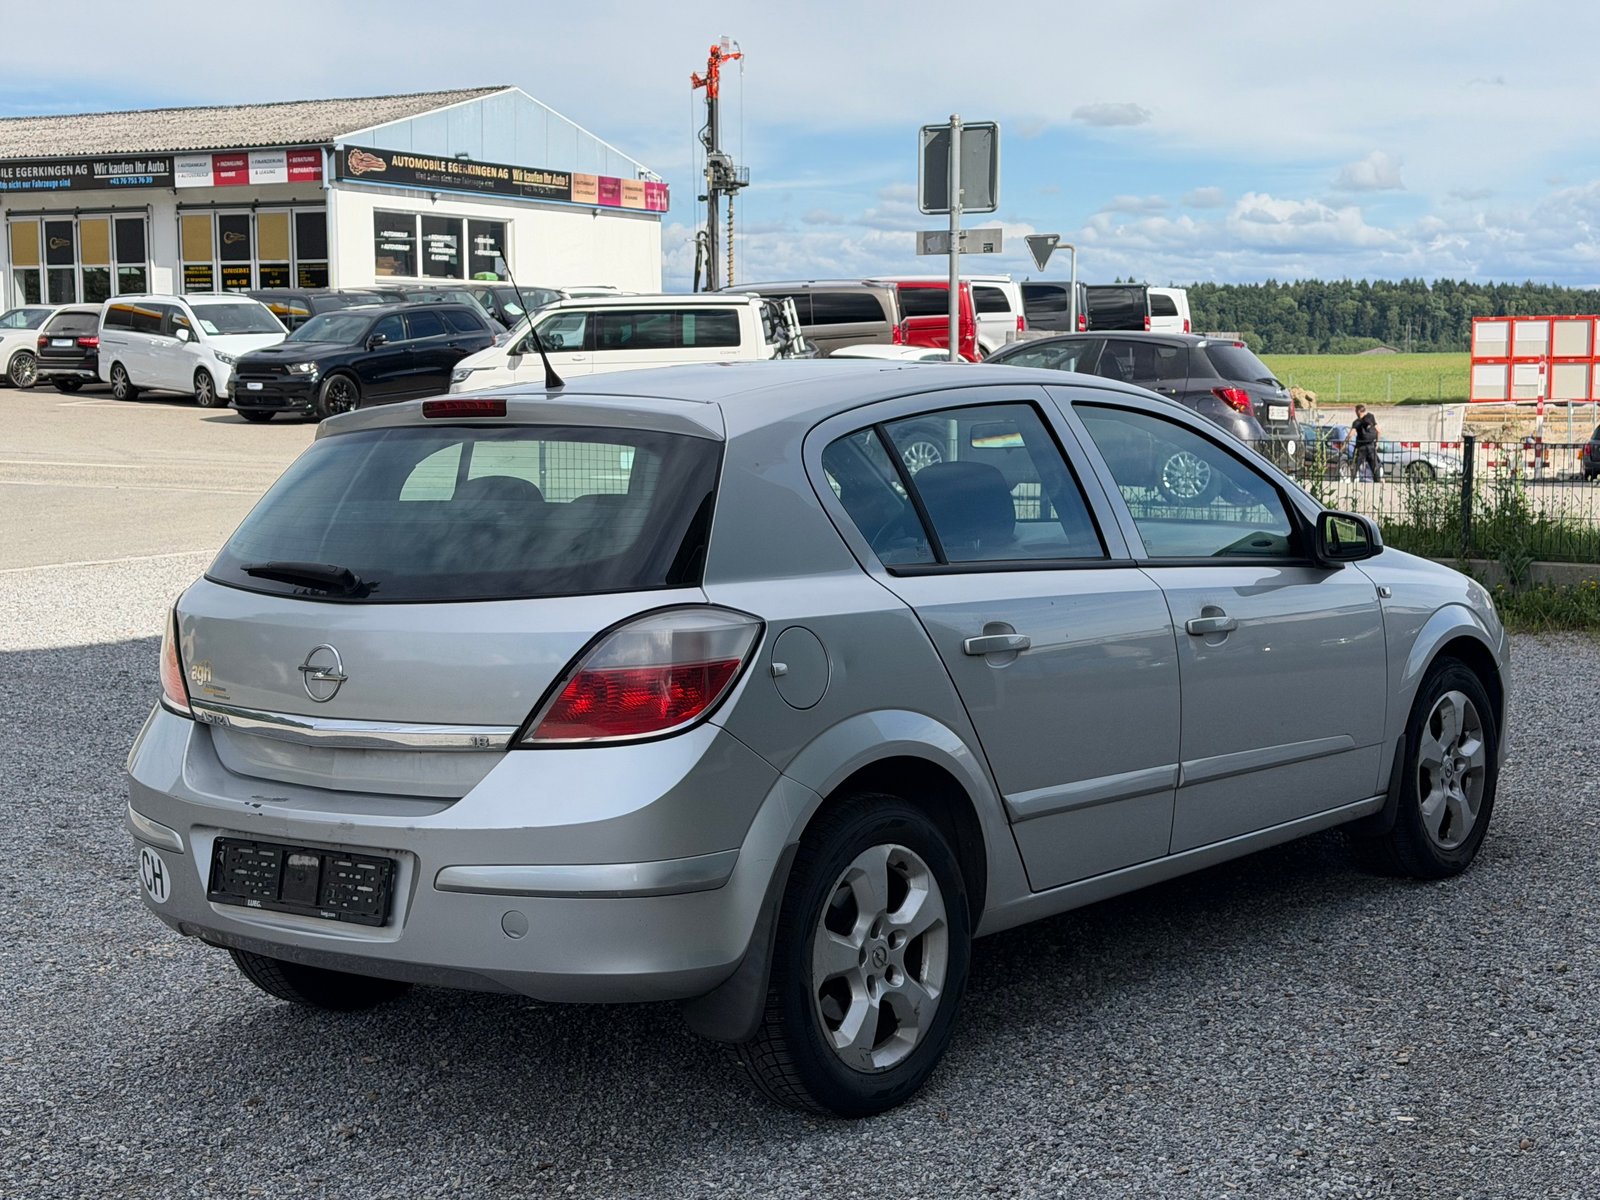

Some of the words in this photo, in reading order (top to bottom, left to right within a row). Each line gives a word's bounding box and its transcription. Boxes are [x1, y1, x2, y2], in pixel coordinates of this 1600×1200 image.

[16, 165, 73, 178] EGERKINGEN
[75, 164, 88, 175] AG
[93, 162, 107, 175] Wir
[109, 161, 134, 174] kaufen
[135, 161, 146, 173] Ihr
[147, 160, 165, 172] Auto
[392, 155, 446, 172] AUTOMOBILE
[448, 162, 498, 178] EGERKINGEN
[498, 168, 509, 179] AG
[512, 168, 523, 181] Wir
[524, 170, 543, 183] kaufen
[543, 172, 552, 184] Ihr
[552, 173, 566, 186] Auto
[201, 710, 231, 727] ASTRA
[142, 850, 165, 899] CH
